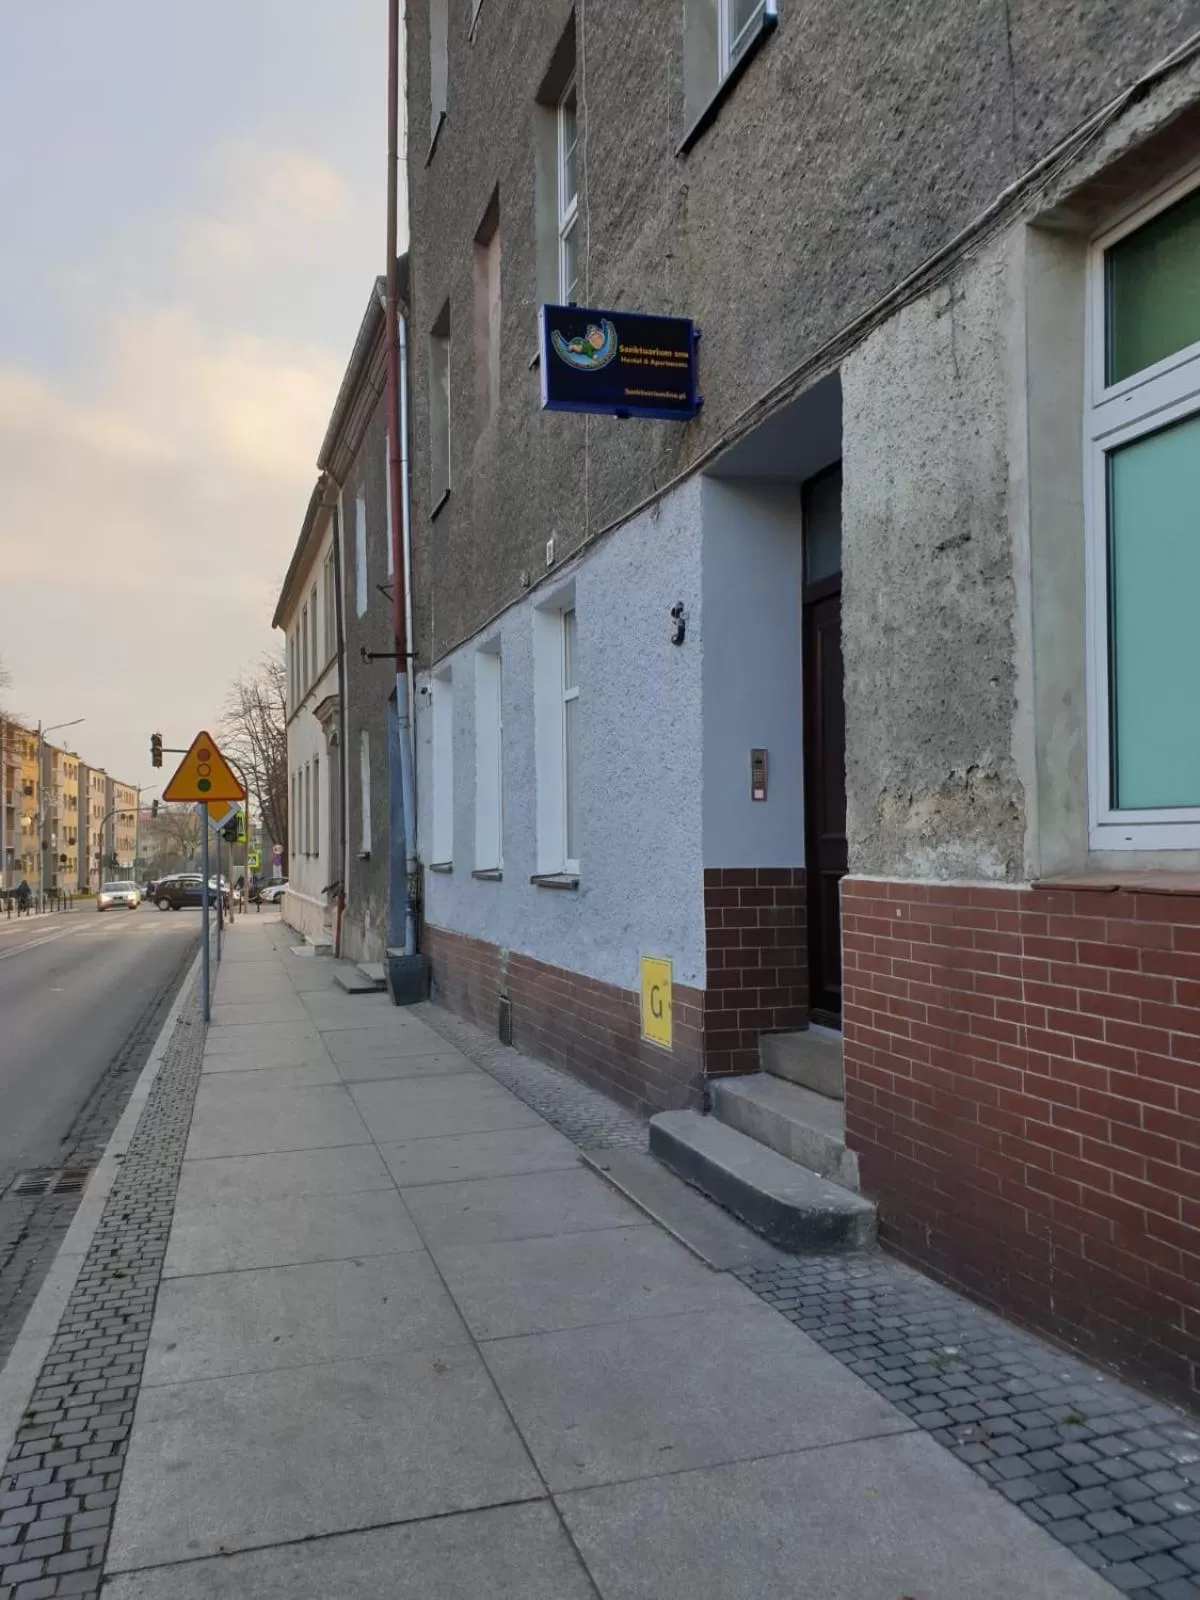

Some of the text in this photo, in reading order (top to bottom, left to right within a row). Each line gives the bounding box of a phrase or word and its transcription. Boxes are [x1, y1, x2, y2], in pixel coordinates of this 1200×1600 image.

[619, 345, 672, 357] Sanktuarium
[621, 356, 642, 364] Hostel
[650, 985, 663, 1019] G
